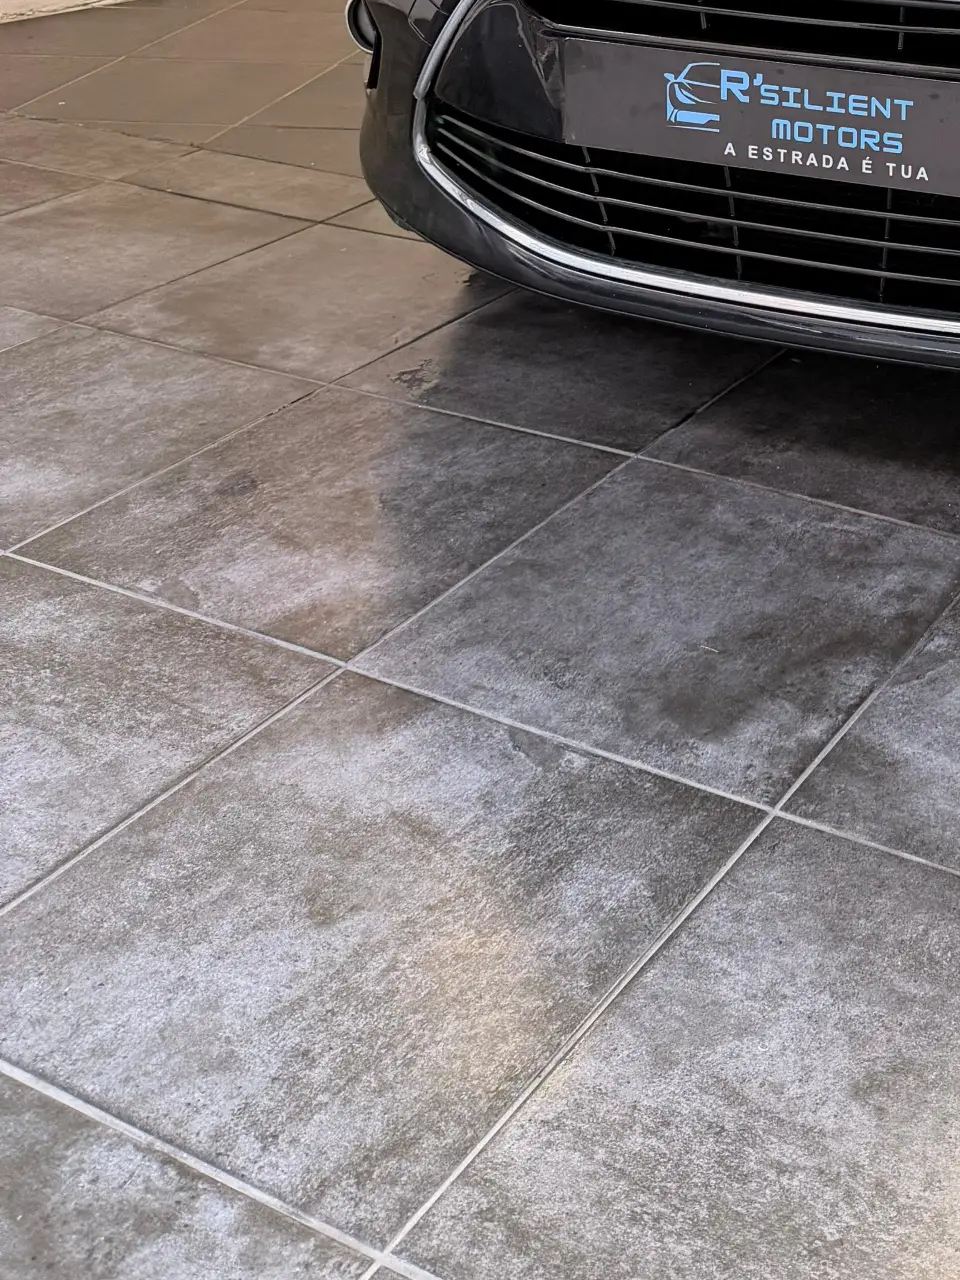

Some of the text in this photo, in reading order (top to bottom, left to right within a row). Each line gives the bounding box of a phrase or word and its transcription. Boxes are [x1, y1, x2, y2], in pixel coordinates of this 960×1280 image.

[720, 69, 914, 120] R'SILIENT
[771, 118, 903, 154] MOTORS
[724, 142, 929, 181] A ESTRADA É TUA
